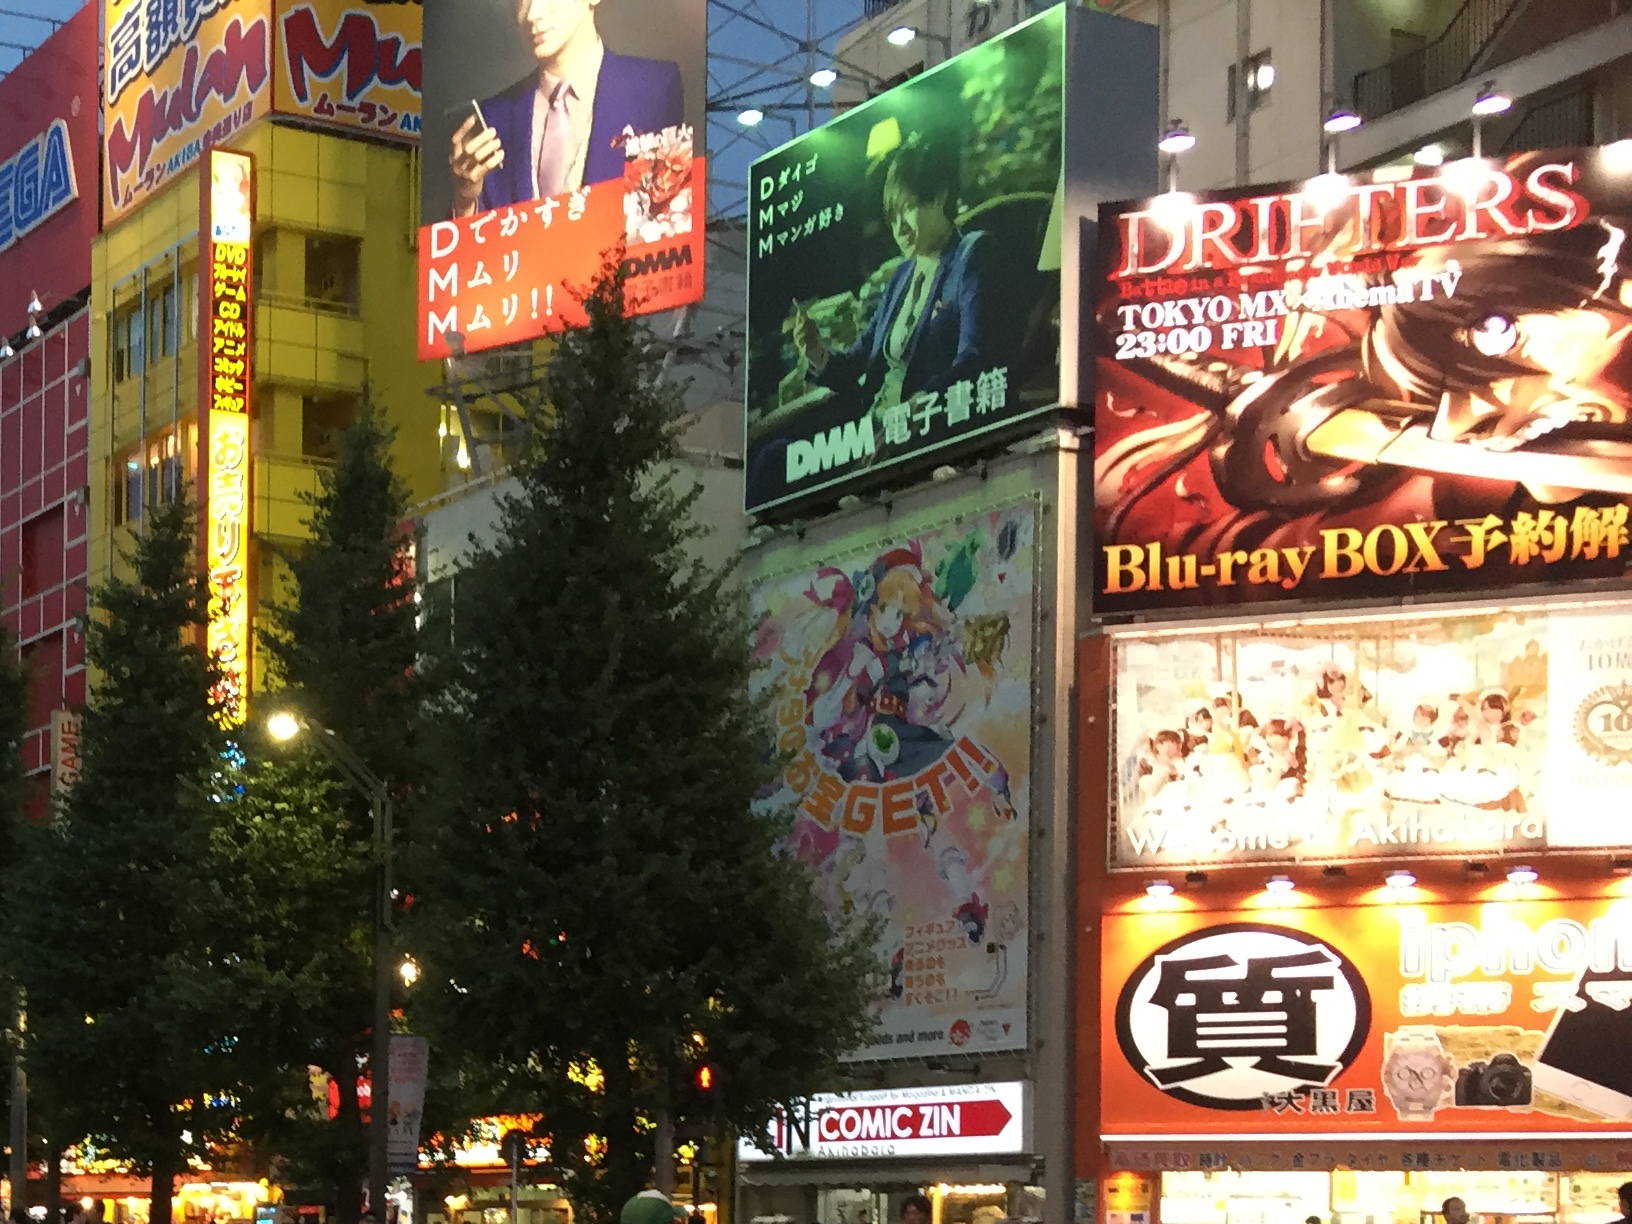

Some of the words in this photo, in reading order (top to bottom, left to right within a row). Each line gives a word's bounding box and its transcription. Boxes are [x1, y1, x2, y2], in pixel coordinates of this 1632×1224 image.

[314, 93, 398, 127] ムーラン
[167, 139, 202, 176] AKIBA
[1115, 164, 1580, 277] DRIFTERS
[215, 243, 246, 265] DVD
[219, 301, 241, 319] CD
[1118, 295, 1231, 331] TOKYO
[1114, 325, 1213, 361] 23:00
[1221, 318, 1278, 350] FRI
[786, 413, 875, 484] DMM
[882, 365, 1008, 446] 電子書籍
[1101, 538, 1314, 596] Blu-ray
[1320, 518, 1451, 579] BOX
[1448, 502, 1631, 569] 予約解
[60, 720, 82, 787] GAME
[1145, 945, 1343, 1091] 質
[820, 1107, 914, 1141] COMIC
[918, 1104, 961, 1137] ZIN
